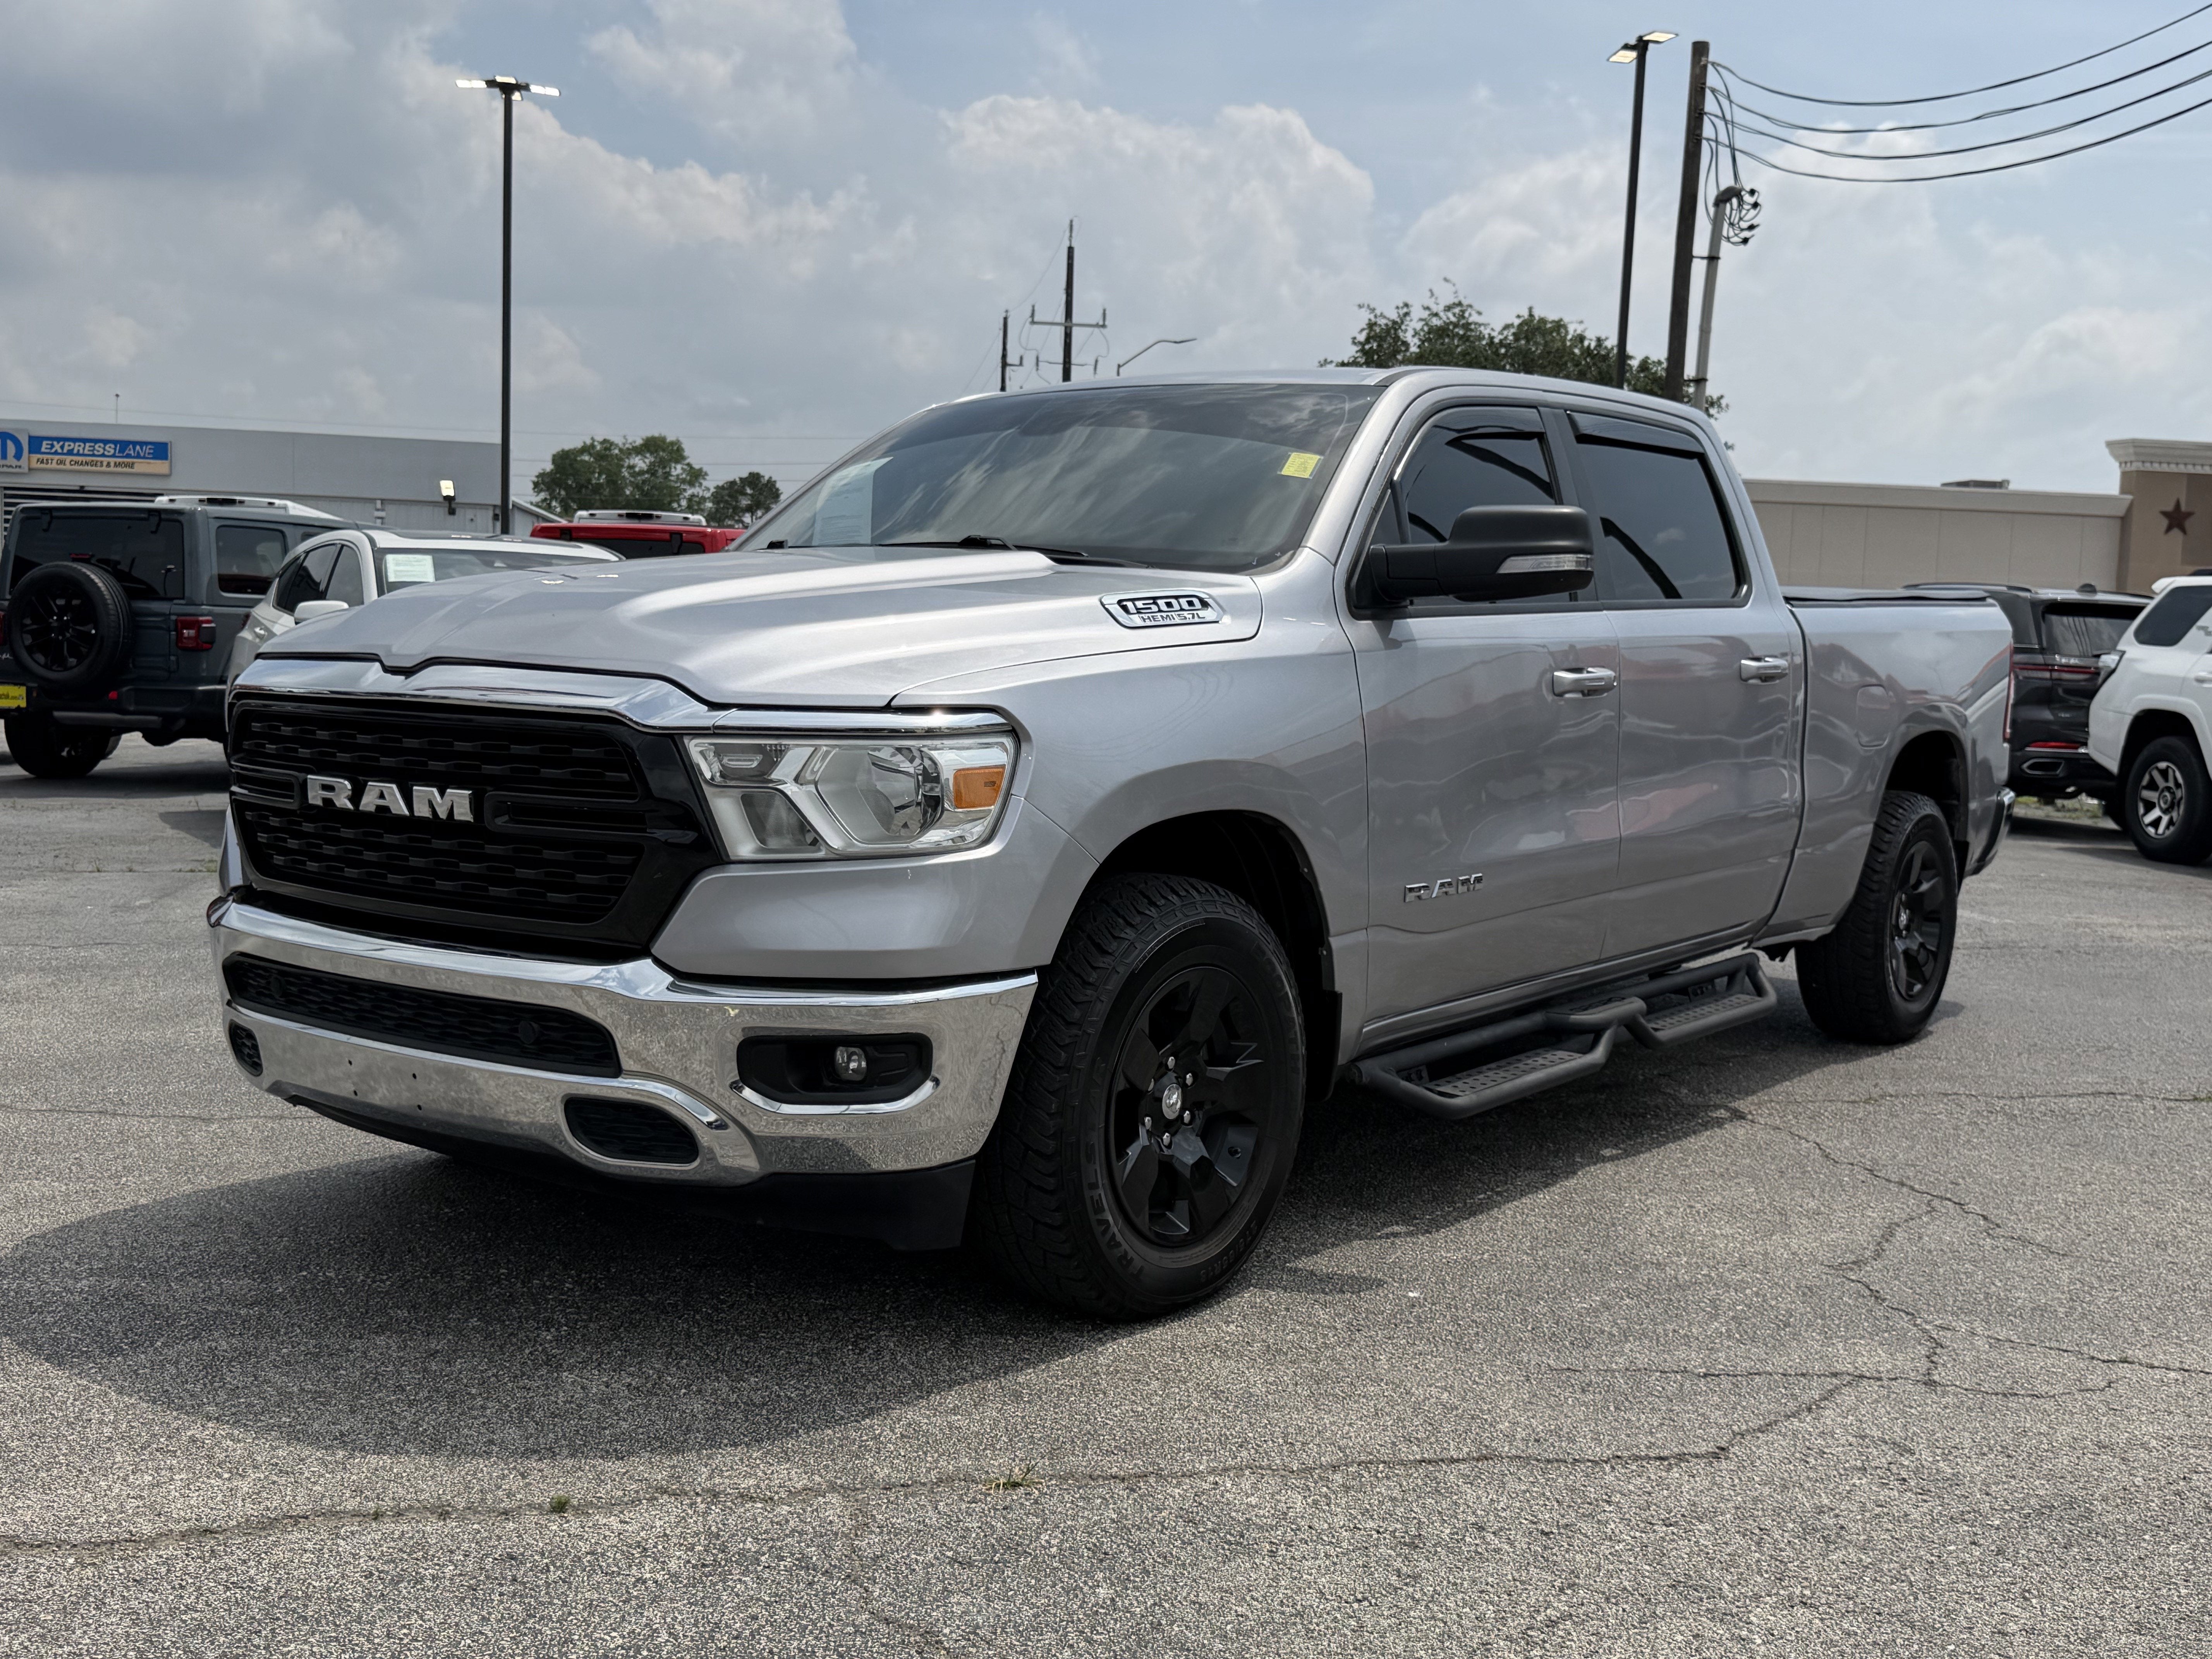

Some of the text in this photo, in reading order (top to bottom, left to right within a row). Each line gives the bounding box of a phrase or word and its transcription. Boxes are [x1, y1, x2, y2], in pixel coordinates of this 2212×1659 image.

[69, 459, 104, 468] CHANGES
[113, 461, 136, 469] MORE
[1120, 597, 1201, 614] 1500
[1140, 614, 1175, 623] HEMI
[307, 775, 474, 822] RAM
[1403, 873, 1483, 903] RAM
